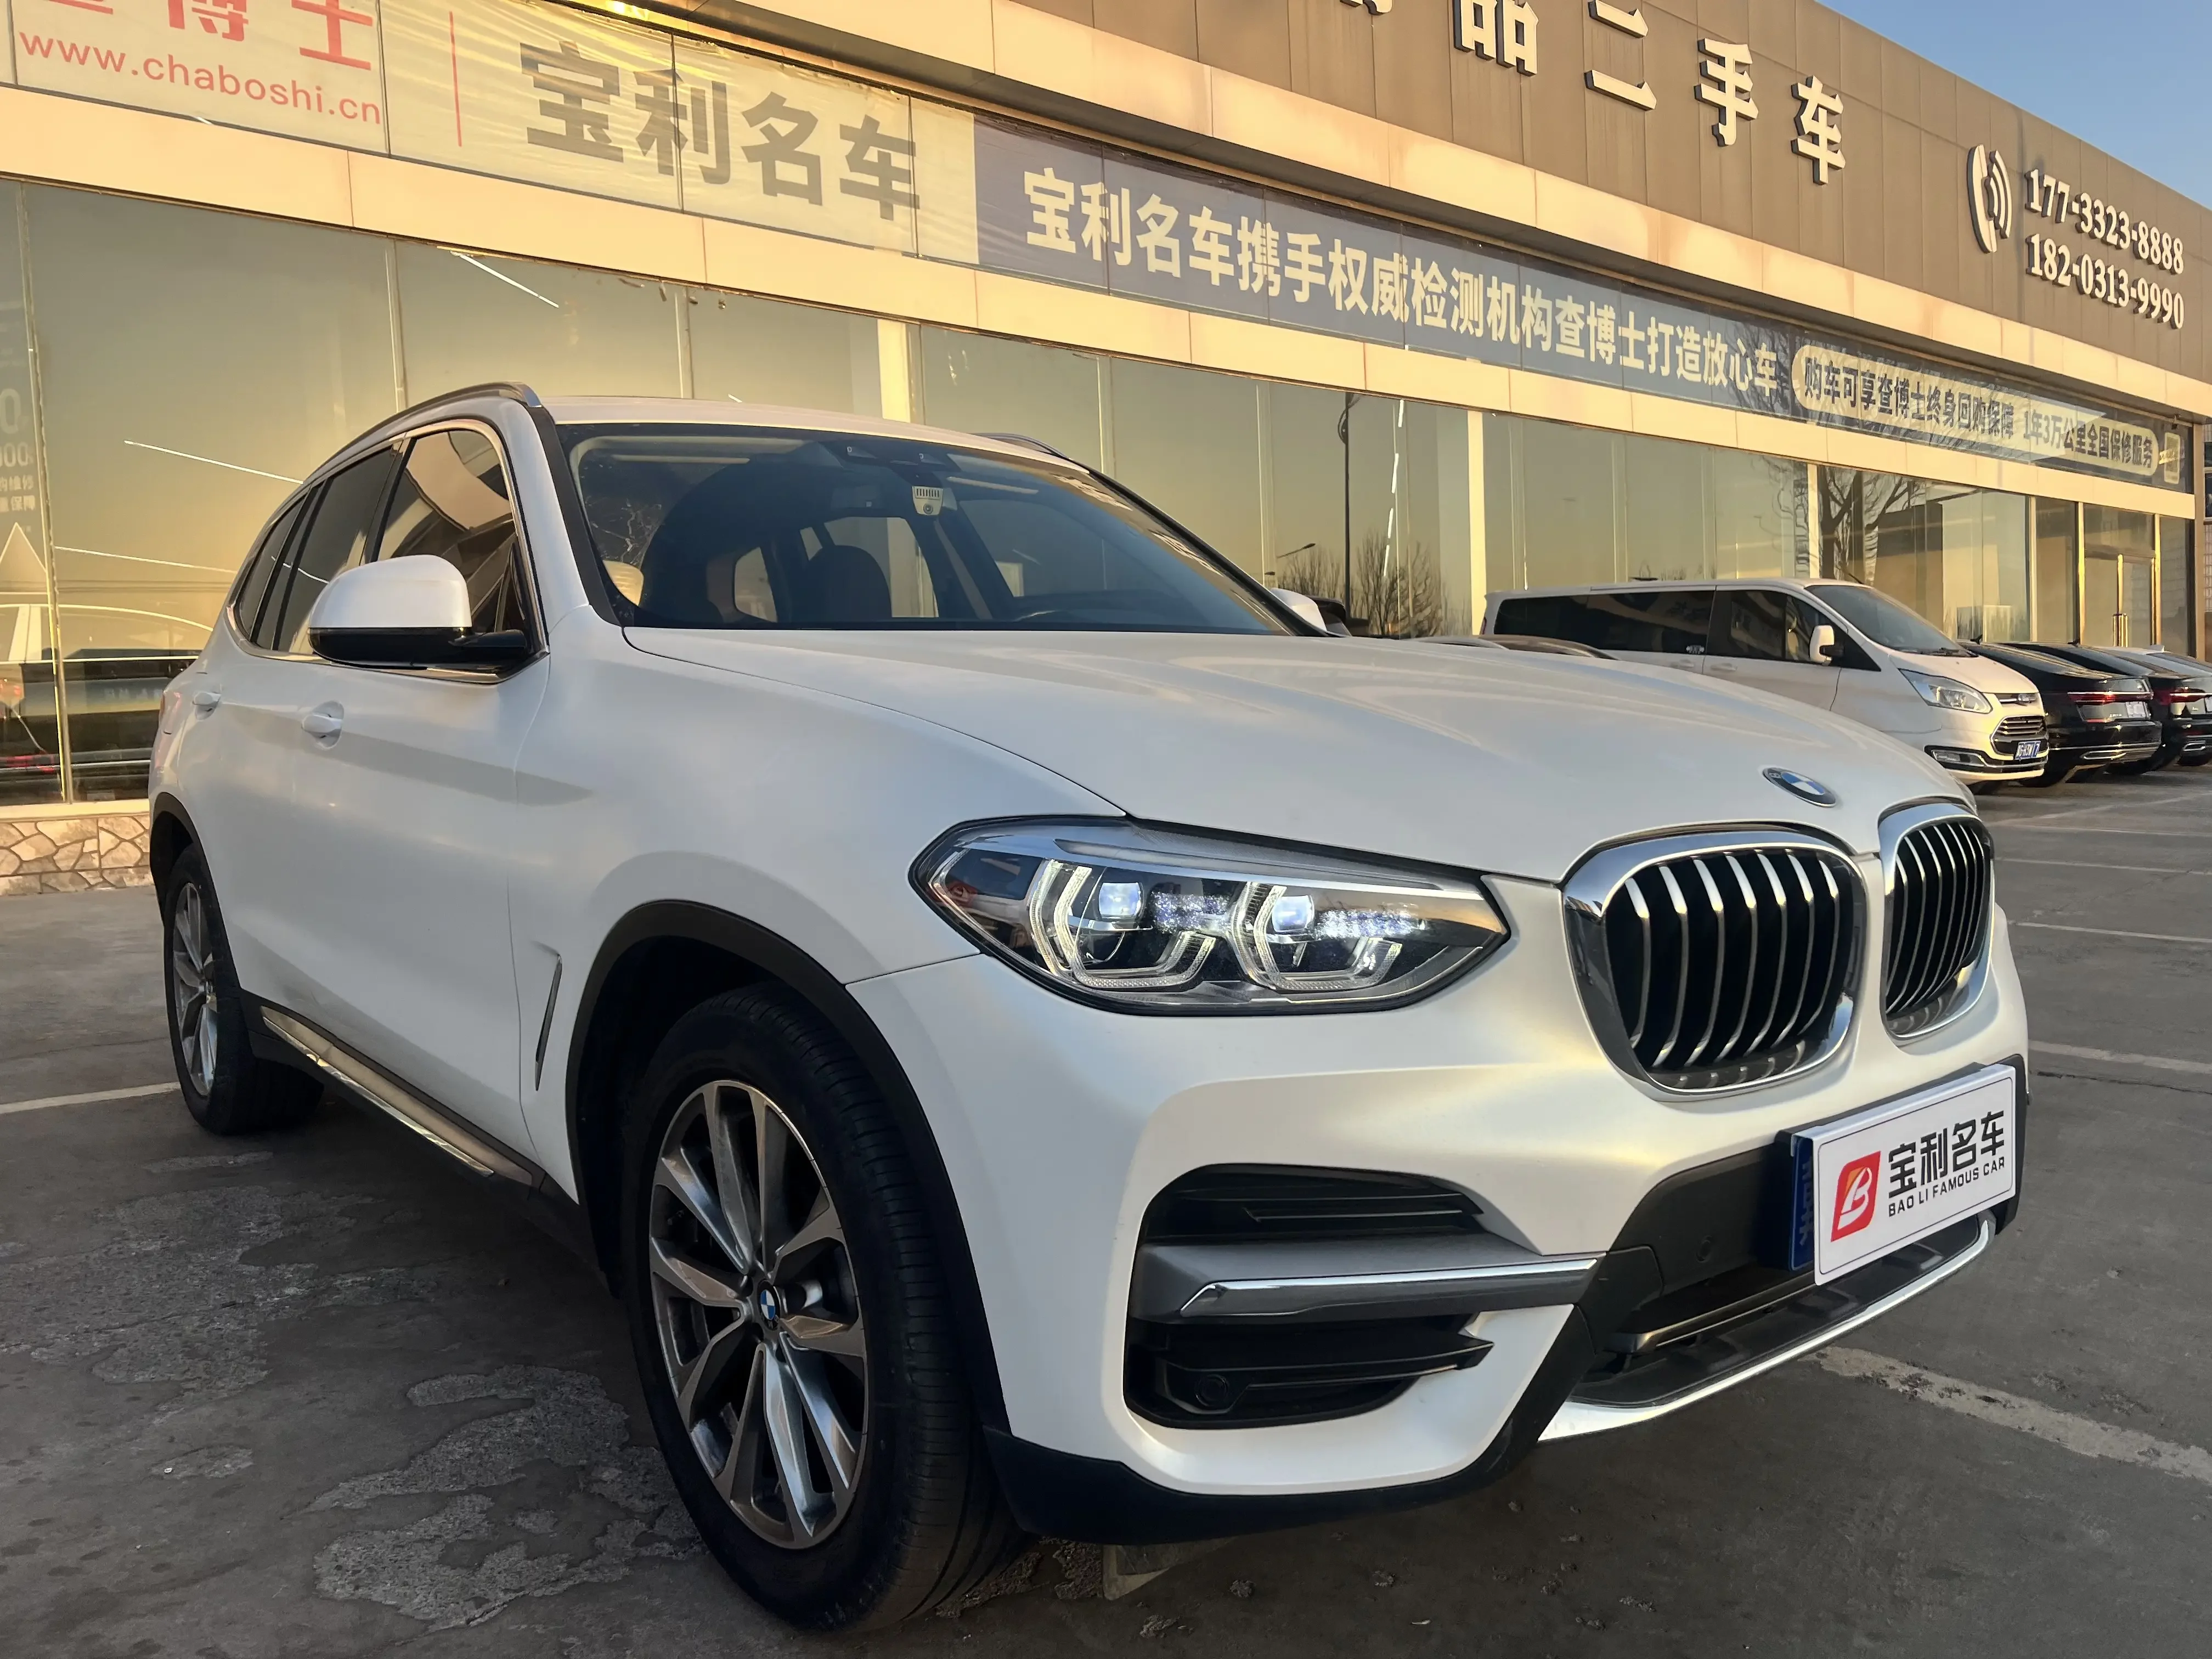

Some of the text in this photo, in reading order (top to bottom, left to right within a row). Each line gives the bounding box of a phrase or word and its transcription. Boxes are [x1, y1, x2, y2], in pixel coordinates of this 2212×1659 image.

[19, 32, 381, 124] www.chaboshi.cn
[1340, 0, 1846, 185] 品二手车
[520, 41, 920, 221] 宝利名车
[2025, 169, 2184, 274] 177-3323-8888
[1024, 167, 1778, 397] 宝利名车携手权威检测机构查博士打造放心车
[2026, 234, 2185, 329] 182-0313-9990
[1888, 1110, 2005, 1199] 宝利名车
[1889, 1156, 2005, 1217] BAO LI FAMOUS CAR
